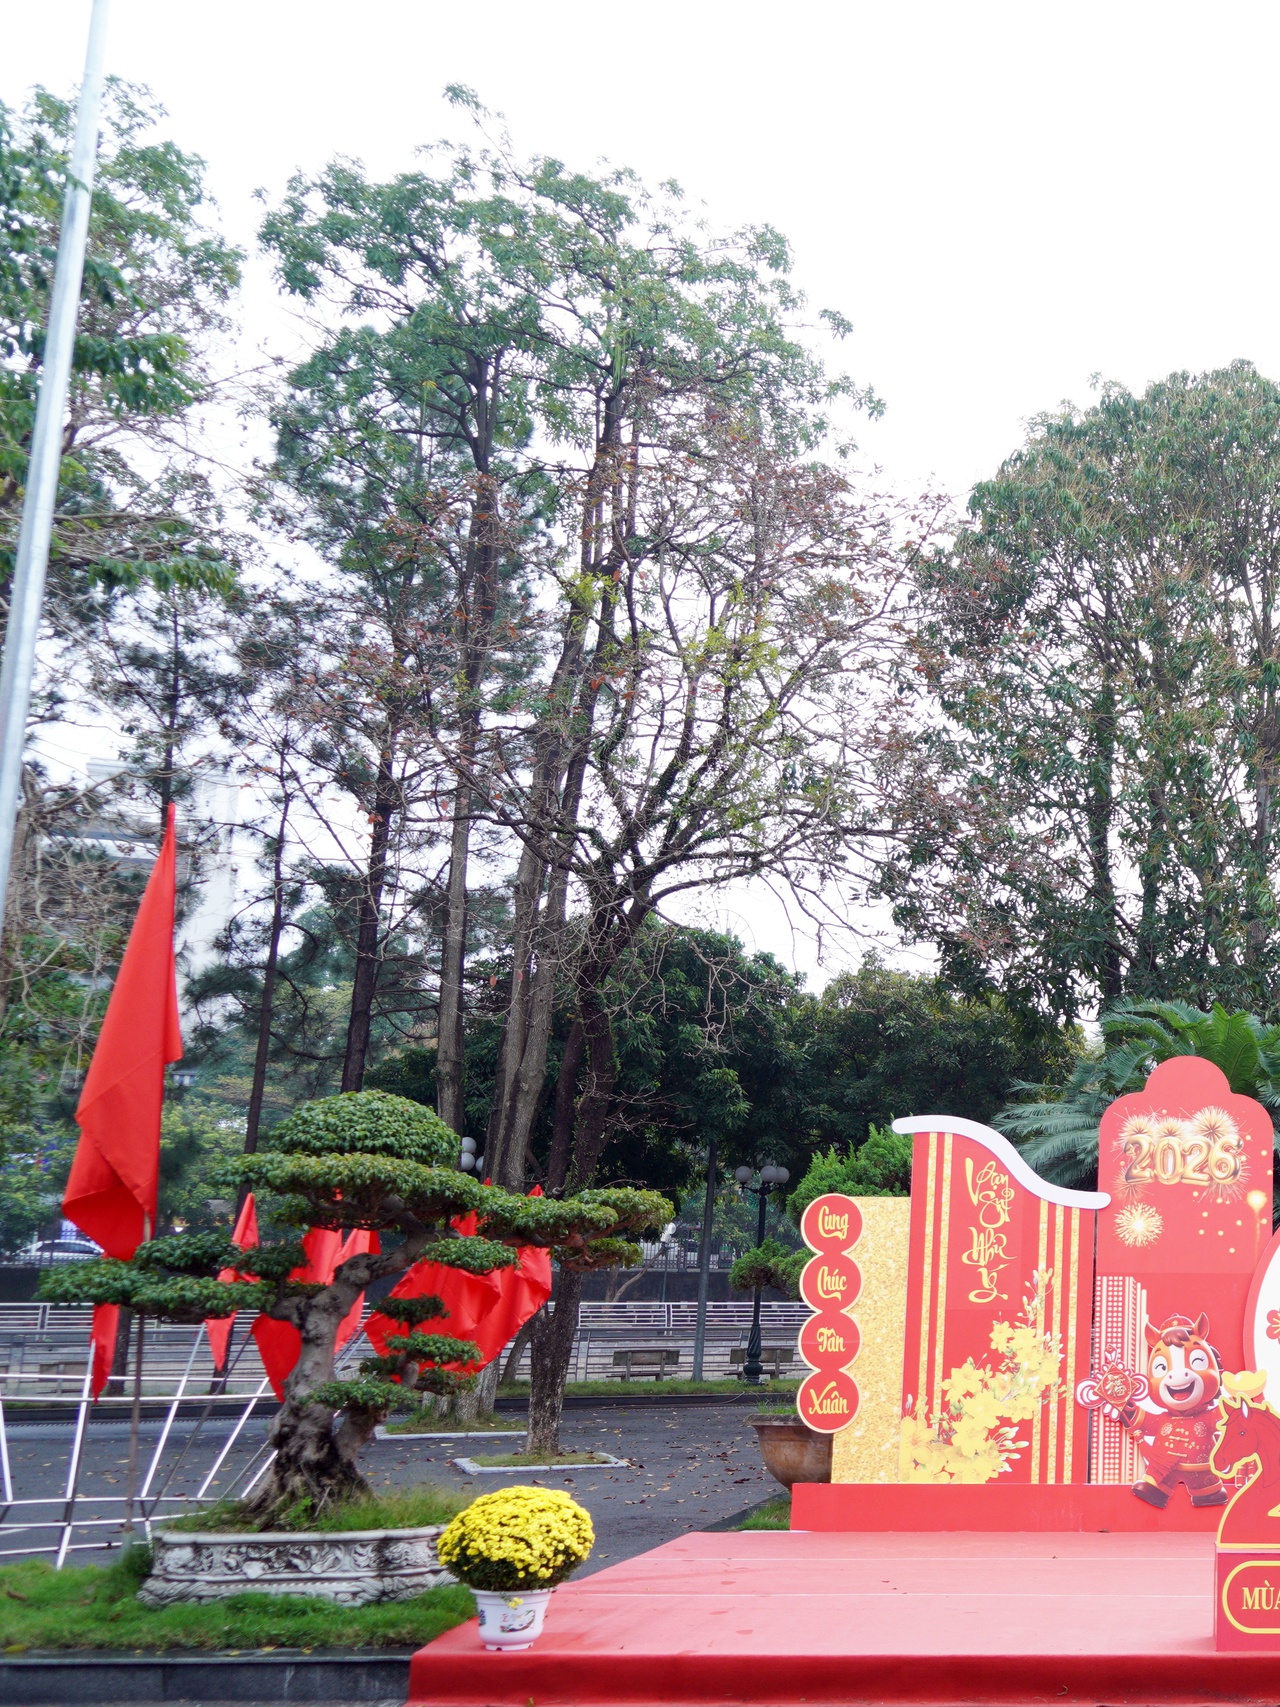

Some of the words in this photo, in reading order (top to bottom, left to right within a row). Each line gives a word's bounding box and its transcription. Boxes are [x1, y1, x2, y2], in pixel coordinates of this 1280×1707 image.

[1123, 1134, 1245, 1187] 2026
[965, 1157, 1009, 1207] Vạn
[818, 1205, 849, 1241] Cung
[961, 1226, 1018, 1267] Như
[817, 1265, 847, 1302] Chúc
[816, 1326, 846, 1353] Tân
[808, 1381, 850, 1415] Xuân
